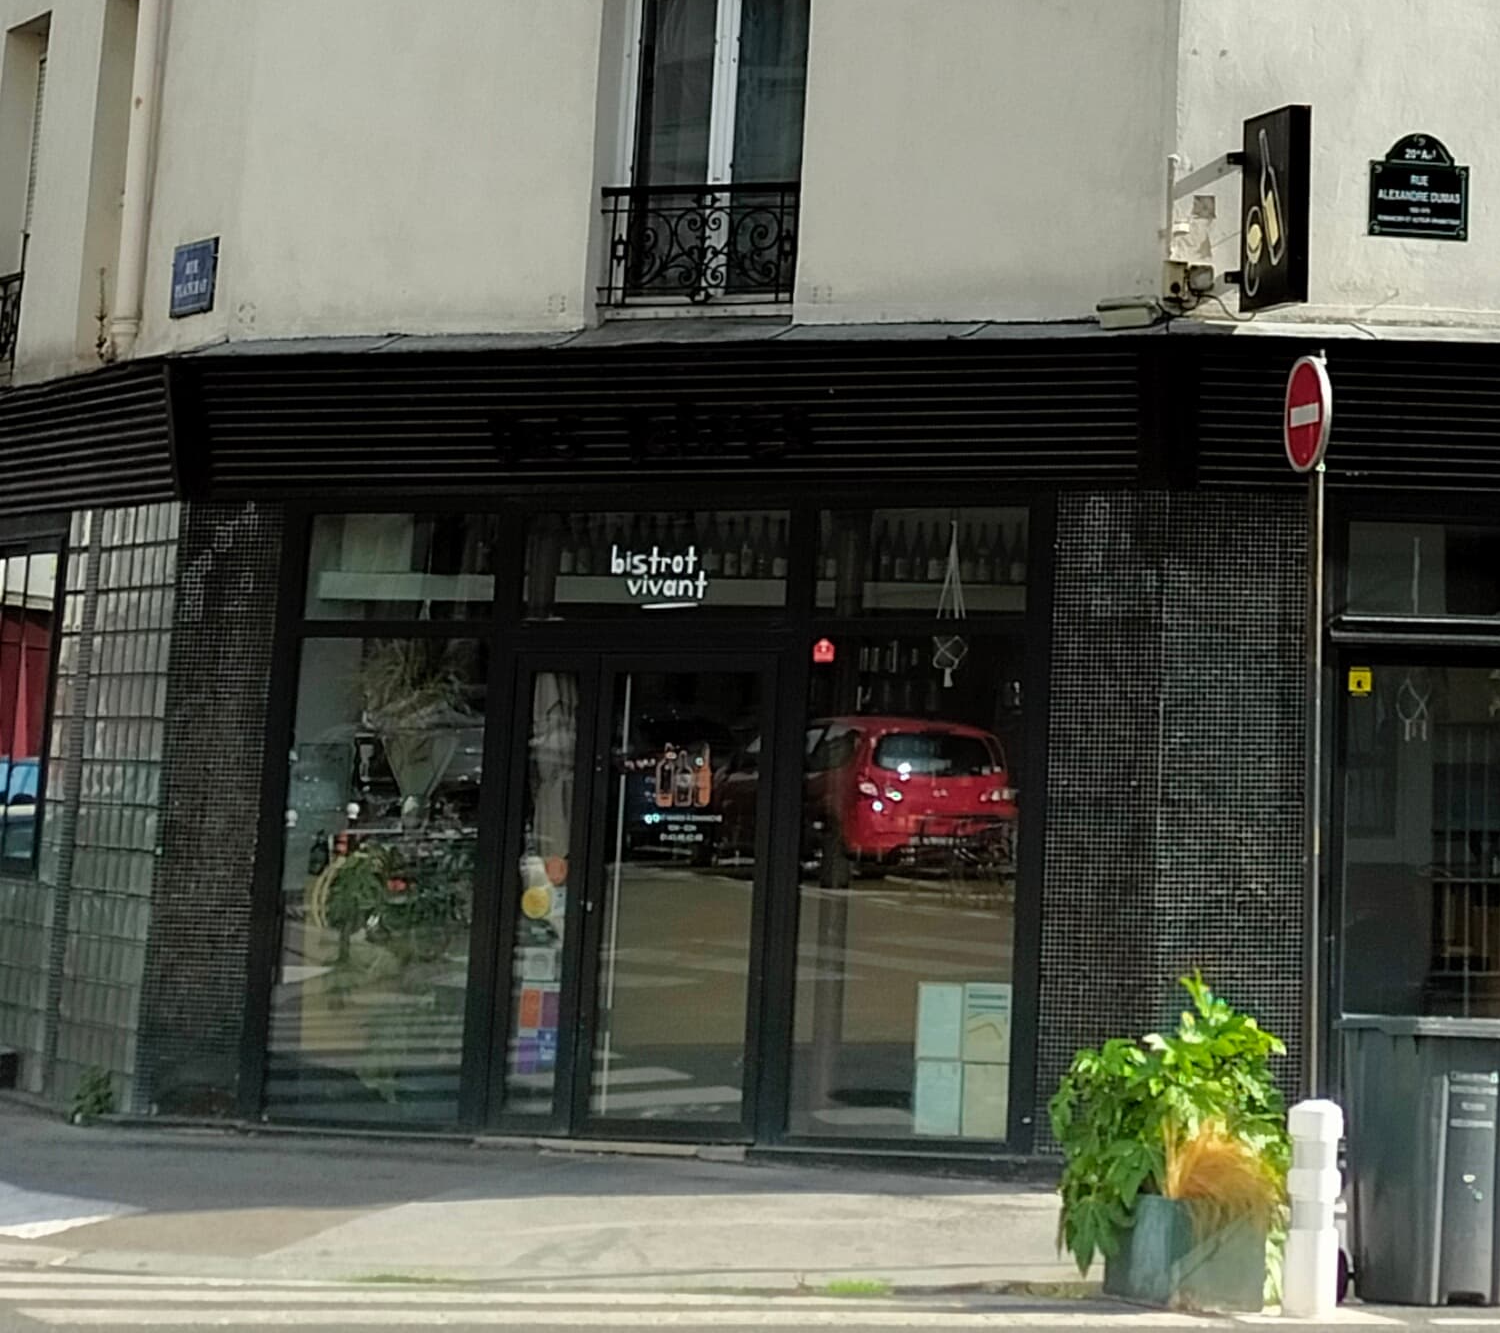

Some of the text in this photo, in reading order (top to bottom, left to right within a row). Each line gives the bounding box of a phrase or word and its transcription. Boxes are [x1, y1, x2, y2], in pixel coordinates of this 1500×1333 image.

[1410, 175, 1429, 186] RUE
[1377, 189, 1460, 204] ALEXANDRE DUMAS
[611, 544, 698, 575] bistrot
[626, 571, 708, 599] vivant
